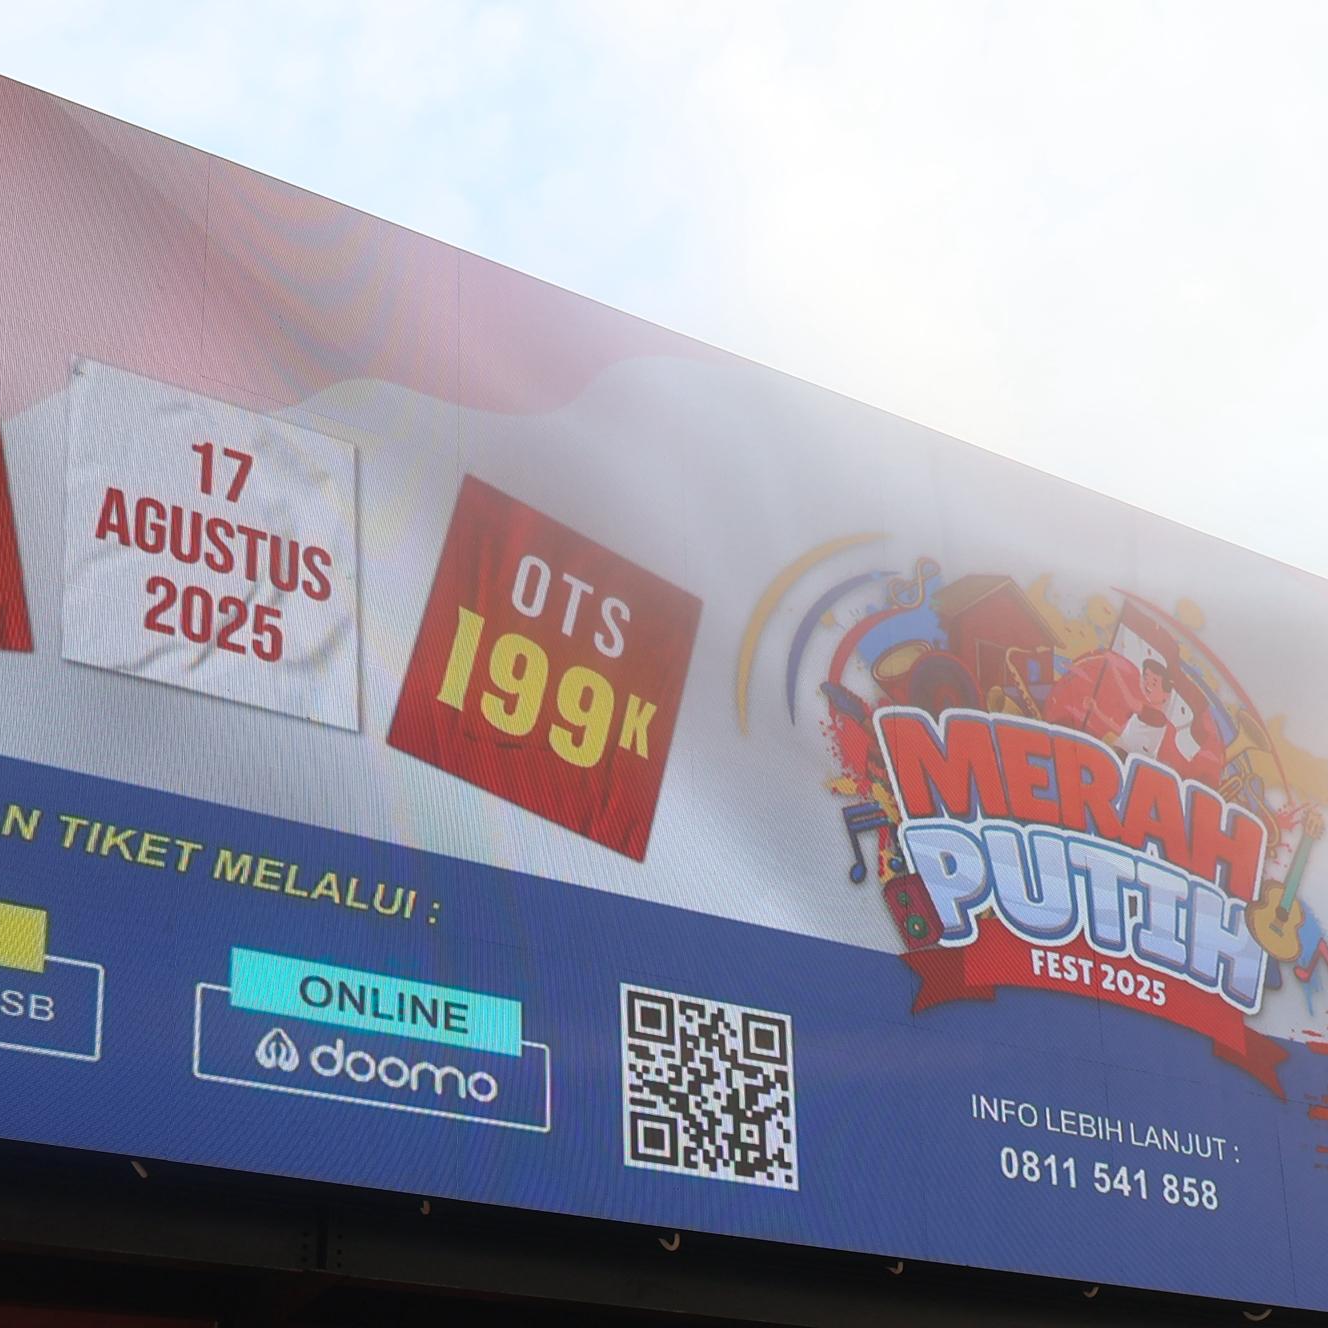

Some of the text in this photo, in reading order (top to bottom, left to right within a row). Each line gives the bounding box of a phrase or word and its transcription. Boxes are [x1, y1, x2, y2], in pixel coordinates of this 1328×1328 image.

[191, 442, 254, 503] 17
[95, 488, 332, 600] AGUSTUS
[144, 577, 283, 663] 2025
[511, 554, 630, 658] OTS
[436, 605, 657, 768] 199K
[878, 708, 1264, 900] MERAH
[58, 815, 202, 873] TIKET
[903, 822, 1263, 1008] PUTIH
[298, 973, 469, 1035] ONLINE
[1030, 949, 1166, 1006] FEST 2025
[310, 1038, 498, 1102] doomo
[972, 1094, 1039, 1131] INFO
[1045, 1106, 1123, 1143] LEBIH
[1000, 1146, 1219, 1210] 0811 541 858
